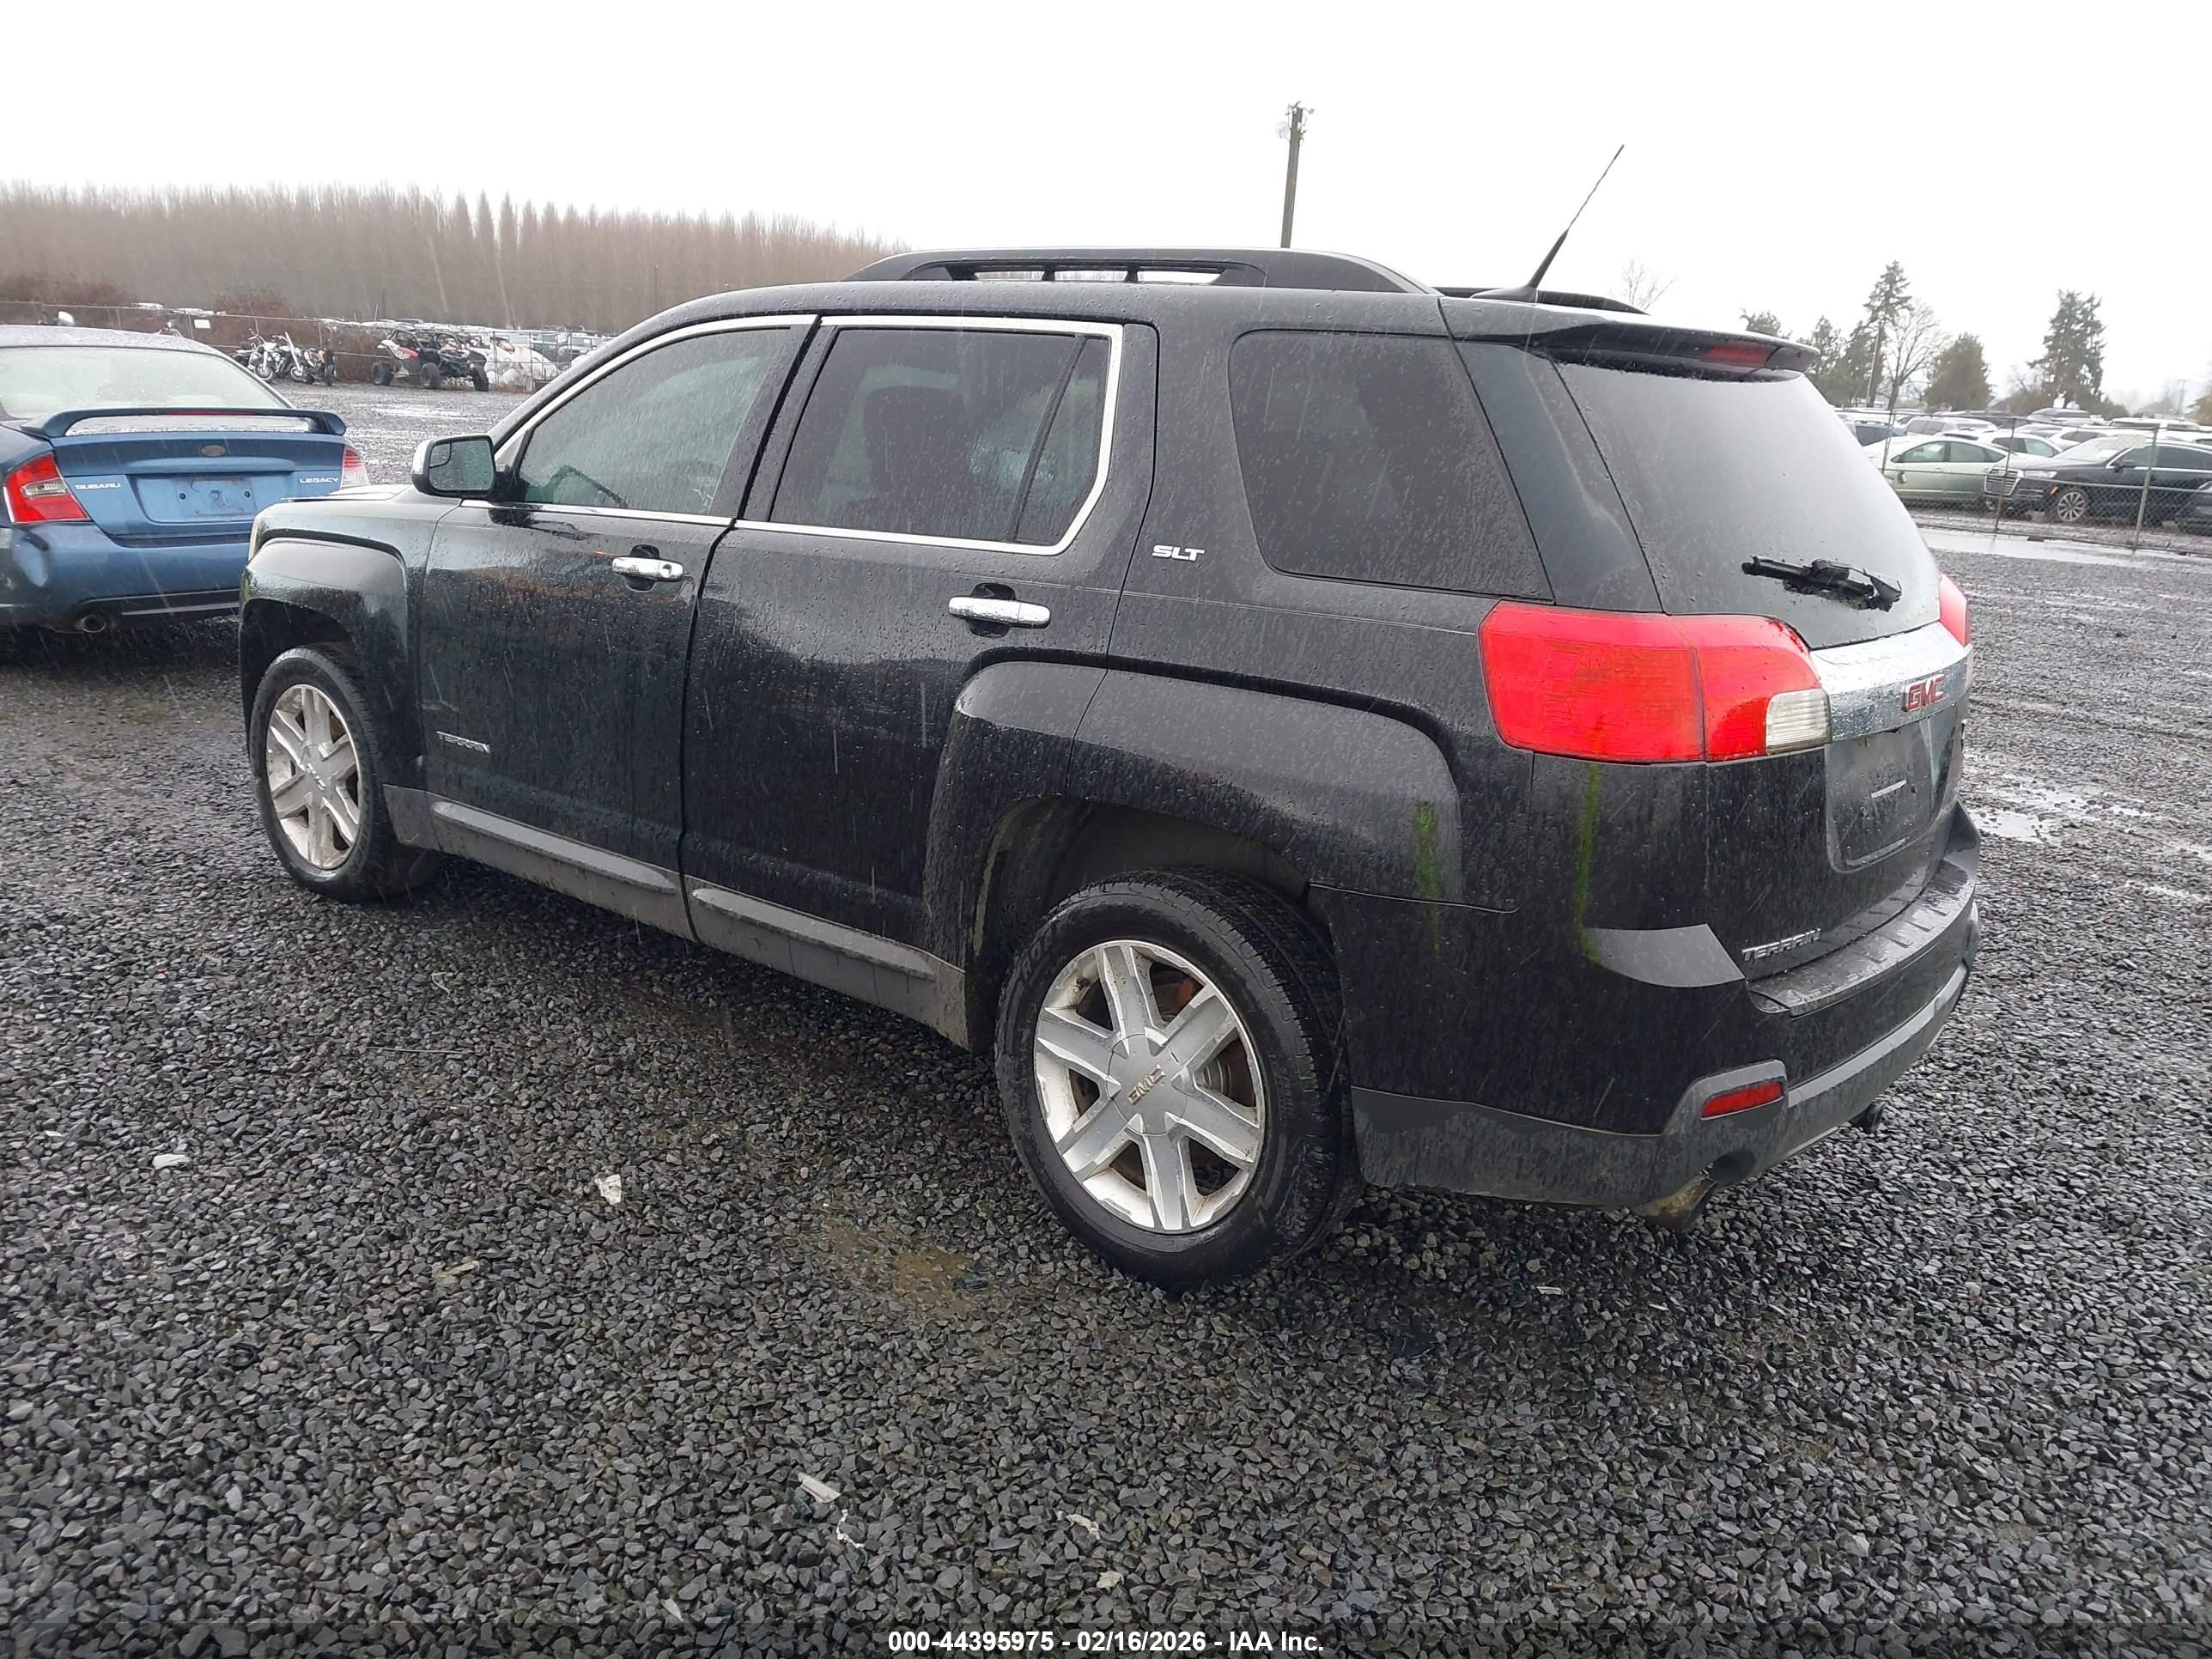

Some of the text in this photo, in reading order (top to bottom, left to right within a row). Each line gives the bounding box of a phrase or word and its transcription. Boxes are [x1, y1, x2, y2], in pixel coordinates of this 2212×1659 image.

[1152, 544, 1206, 562] SLT
[1901, 673, 1946, 712] GMC
[1741, 927, 1821, 962] TERRAIN
[1127, 1064, 1166, 1106] GMC
